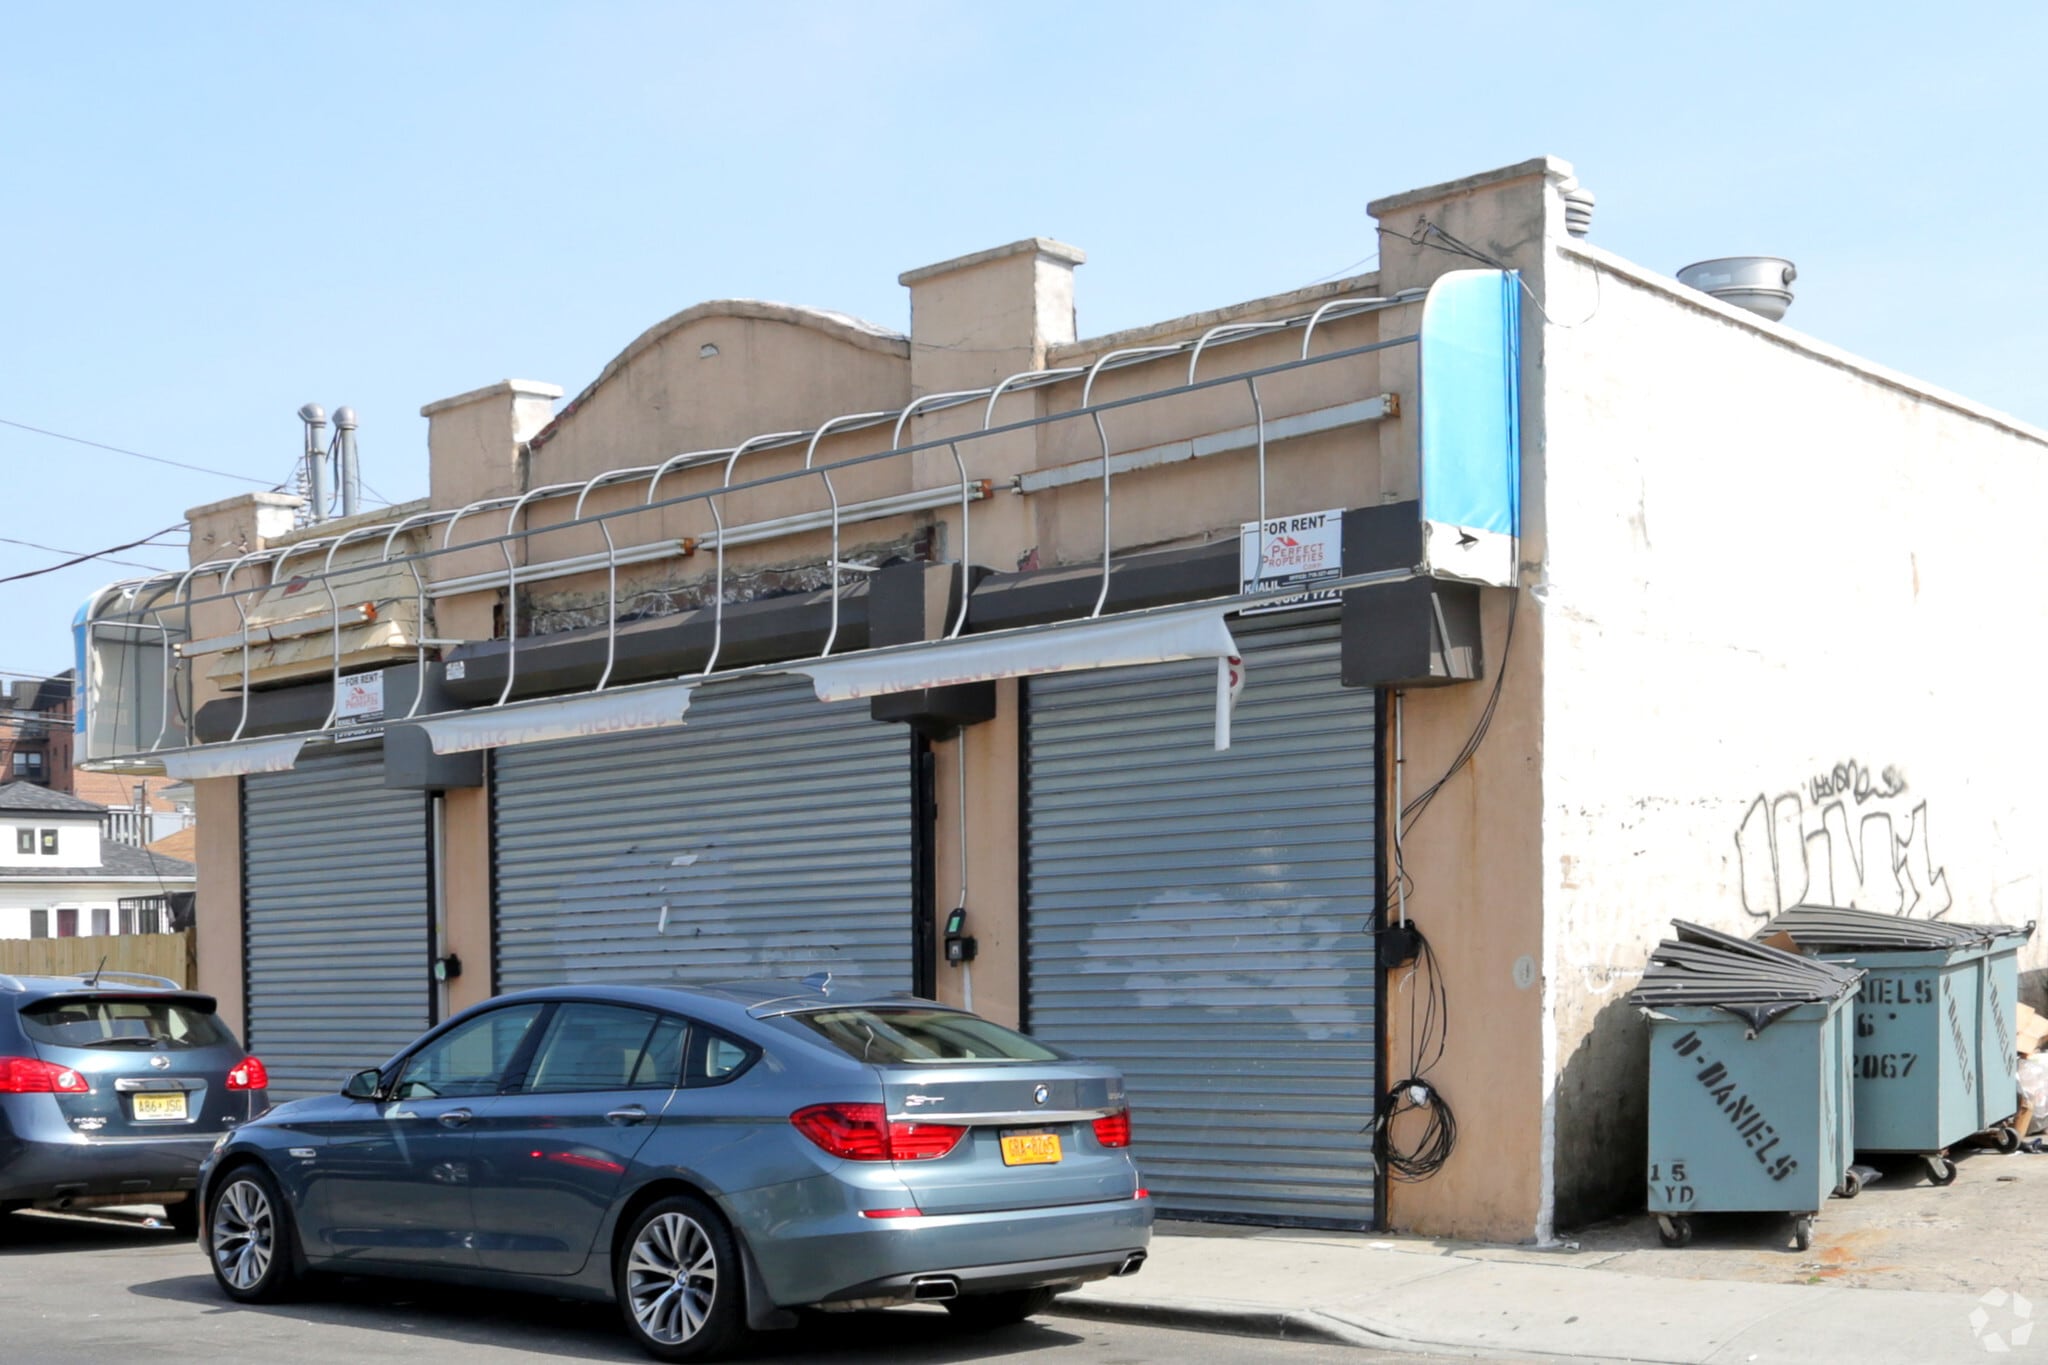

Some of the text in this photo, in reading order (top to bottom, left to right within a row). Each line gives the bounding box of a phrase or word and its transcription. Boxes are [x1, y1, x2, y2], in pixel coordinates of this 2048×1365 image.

[1291, 515, 1326, 532] RENT
[1271, 543, 1324, 558] PERFECT
[1263, 552, 1324, 567] PROPERTIES
[345, 676, 360, 687] FOR
[1665, 1186, 1695, 1204] YD
